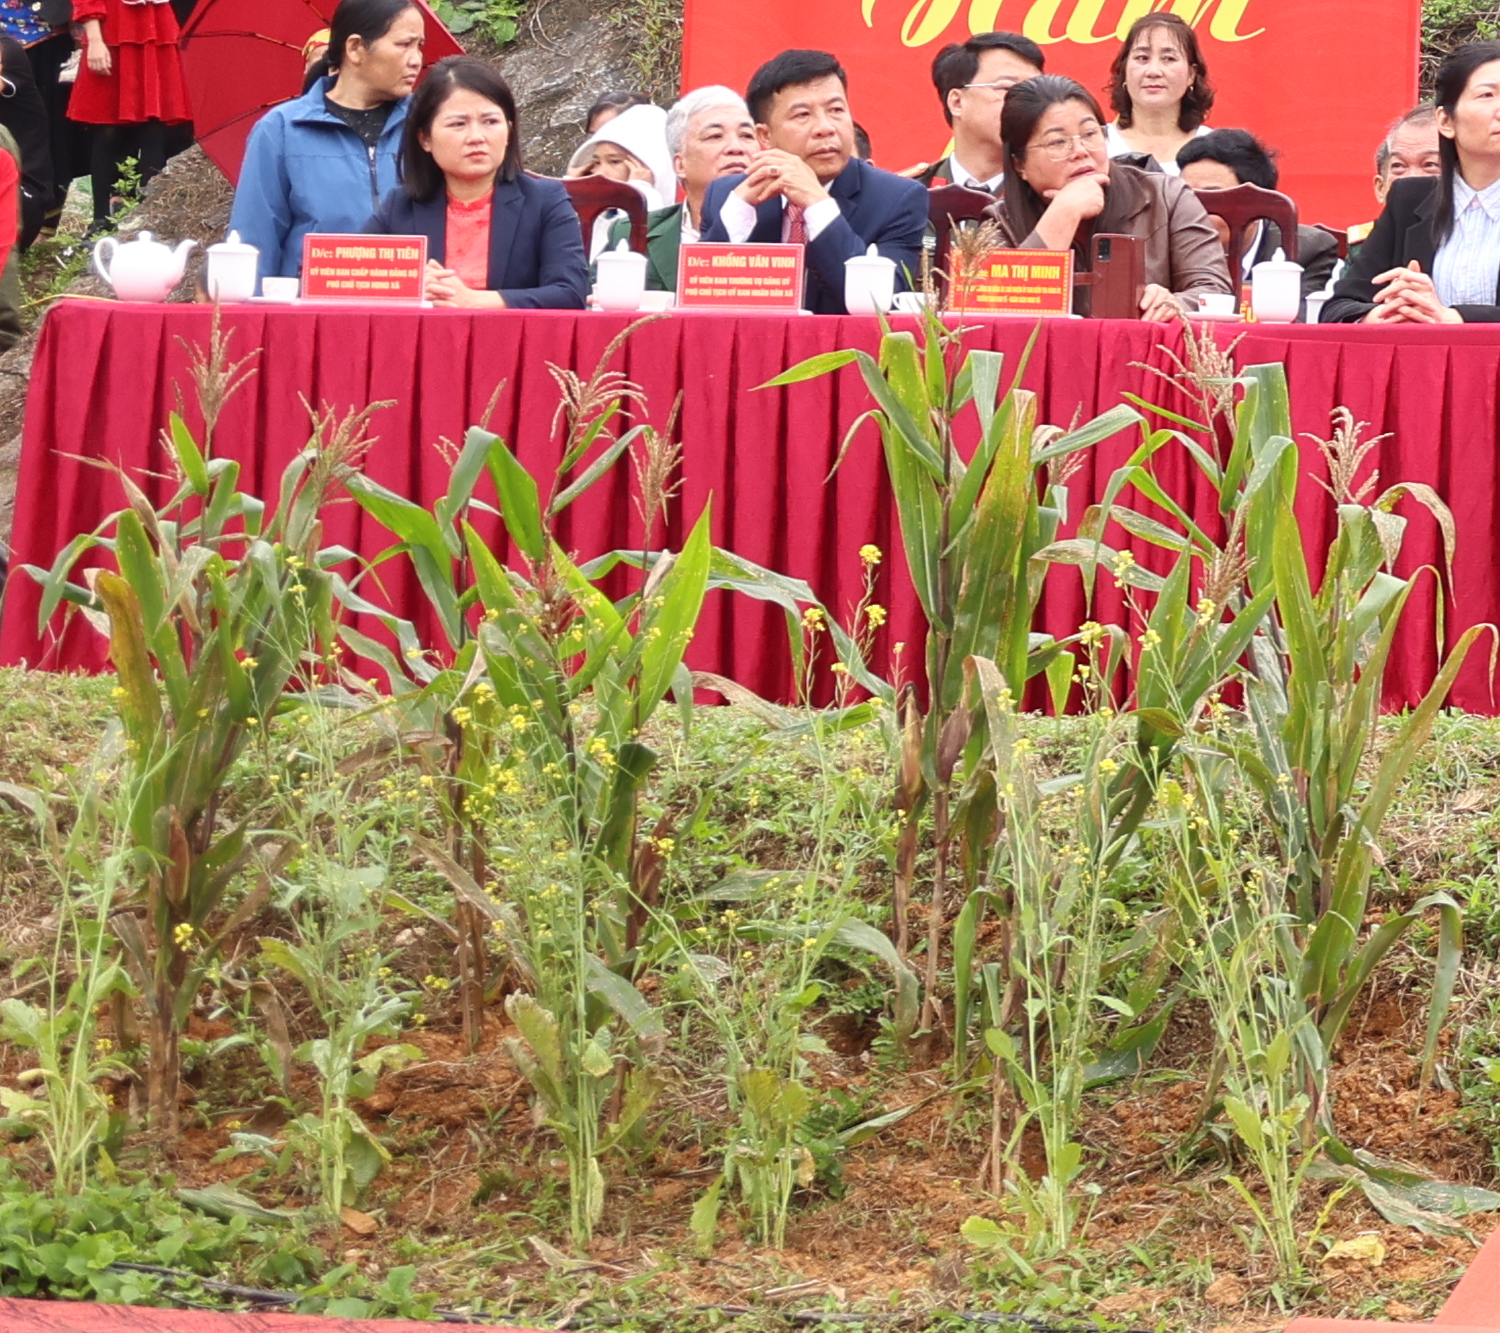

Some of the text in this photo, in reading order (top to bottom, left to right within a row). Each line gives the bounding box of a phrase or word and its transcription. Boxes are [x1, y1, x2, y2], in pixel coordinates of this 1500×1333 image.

[378, 247, 395, 262] THỊ
[748, 254, 769, 268] VĂN
[771, 256, 796, 268] VINH
[991, 264, 1009, 278] MA
[1011, 264, 1029, 281] THỊ
[1031, 265, 1060, 279] MINH
